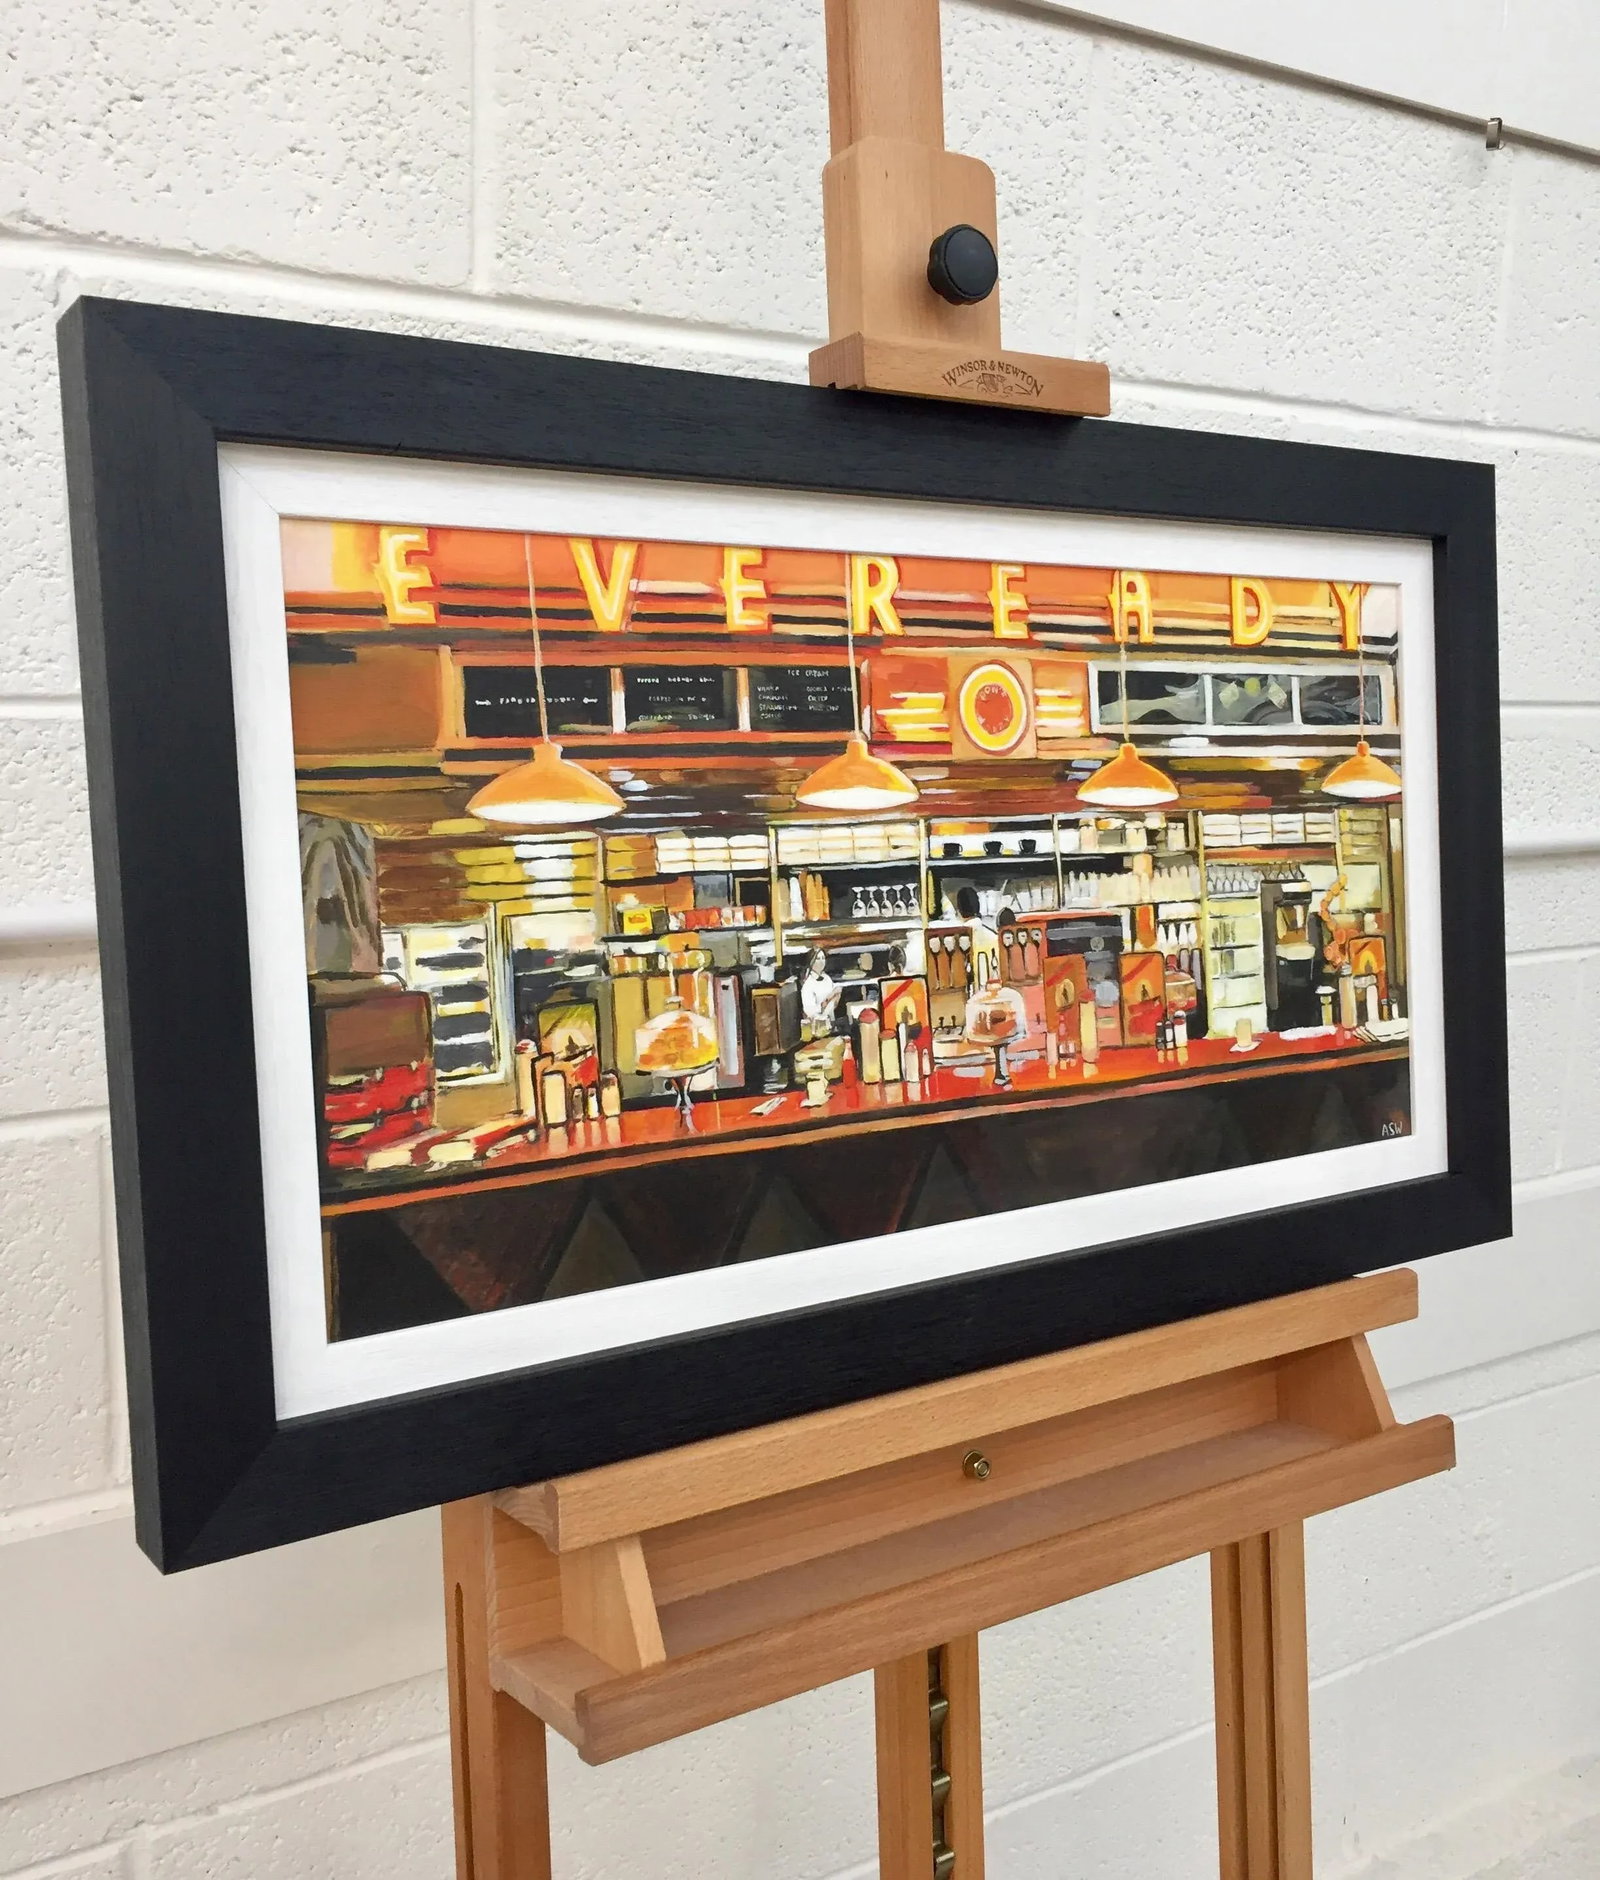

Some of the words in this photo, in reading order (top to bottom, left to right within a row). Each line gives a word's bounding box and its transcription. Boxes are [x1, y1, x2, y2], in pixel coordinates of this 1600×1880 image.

[942, 359, 987, 387] WINSOR
[988, 360, 996, 370] &
[997, 361, 1044, 397] NEWTON
[1381, 1120, 1403, 1137] ASW
